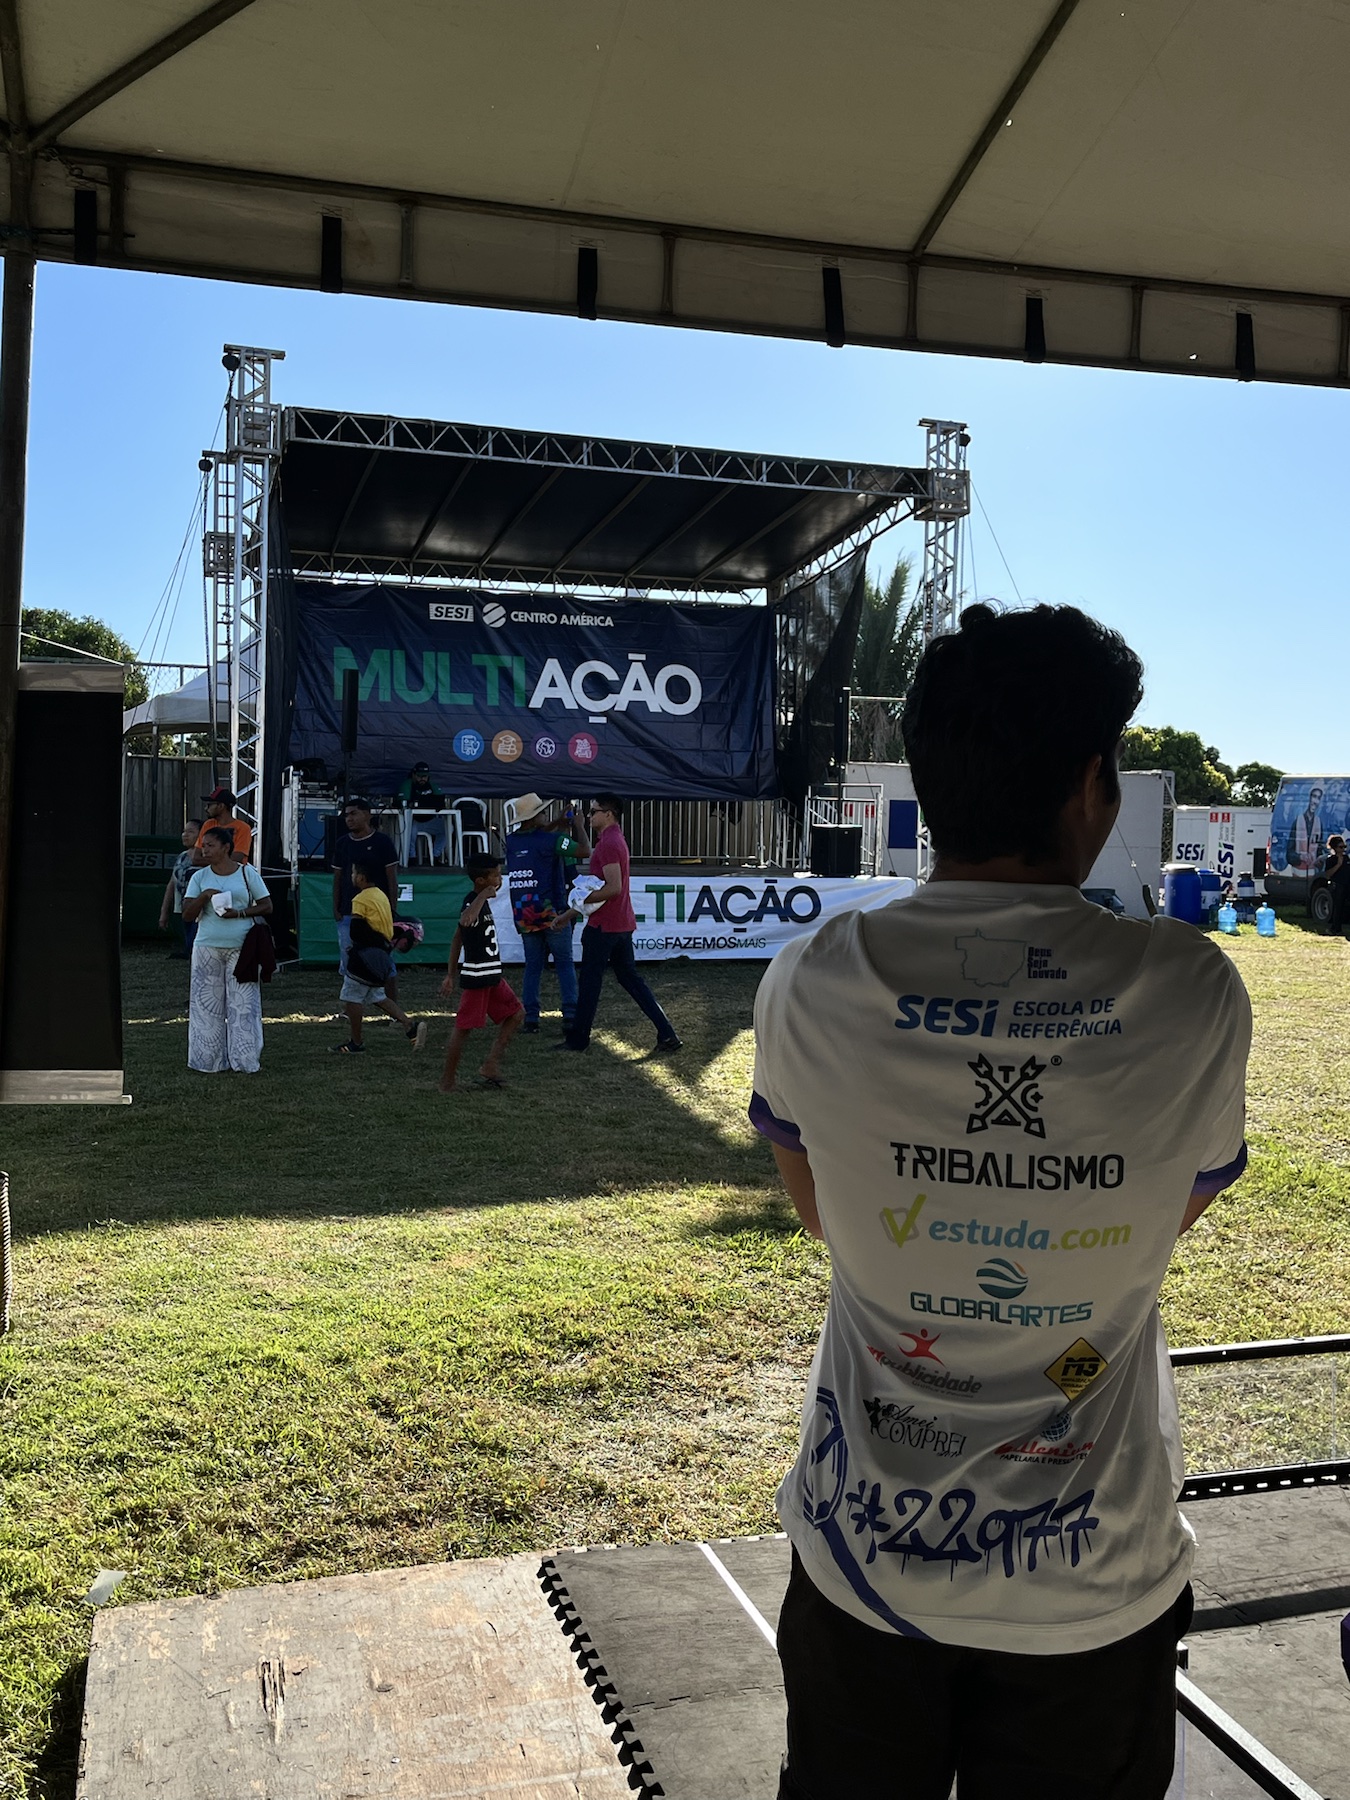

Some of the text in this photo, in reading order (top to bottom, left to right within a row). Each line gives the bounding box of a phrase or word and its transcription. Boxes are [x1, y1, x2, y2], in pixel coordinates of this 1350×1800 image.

[434, 606, 470, 620] SESI
[510, 610, 615, 628] CENTRO AMÉRICA
[509, 879, 539, 889] JUDAR?
[484, 924, 499, 957] 3
[1028, 967, 1067, 979] Louvado
[1013, 997, 1115, 1016] ESCOLA DE
[1008, 1018, 1122, 1038] REFERÊNCIA
[890, 1141, 1125, 1191] TRIBALISMO
[928, 1219, 1132, 1251] estuda.com
